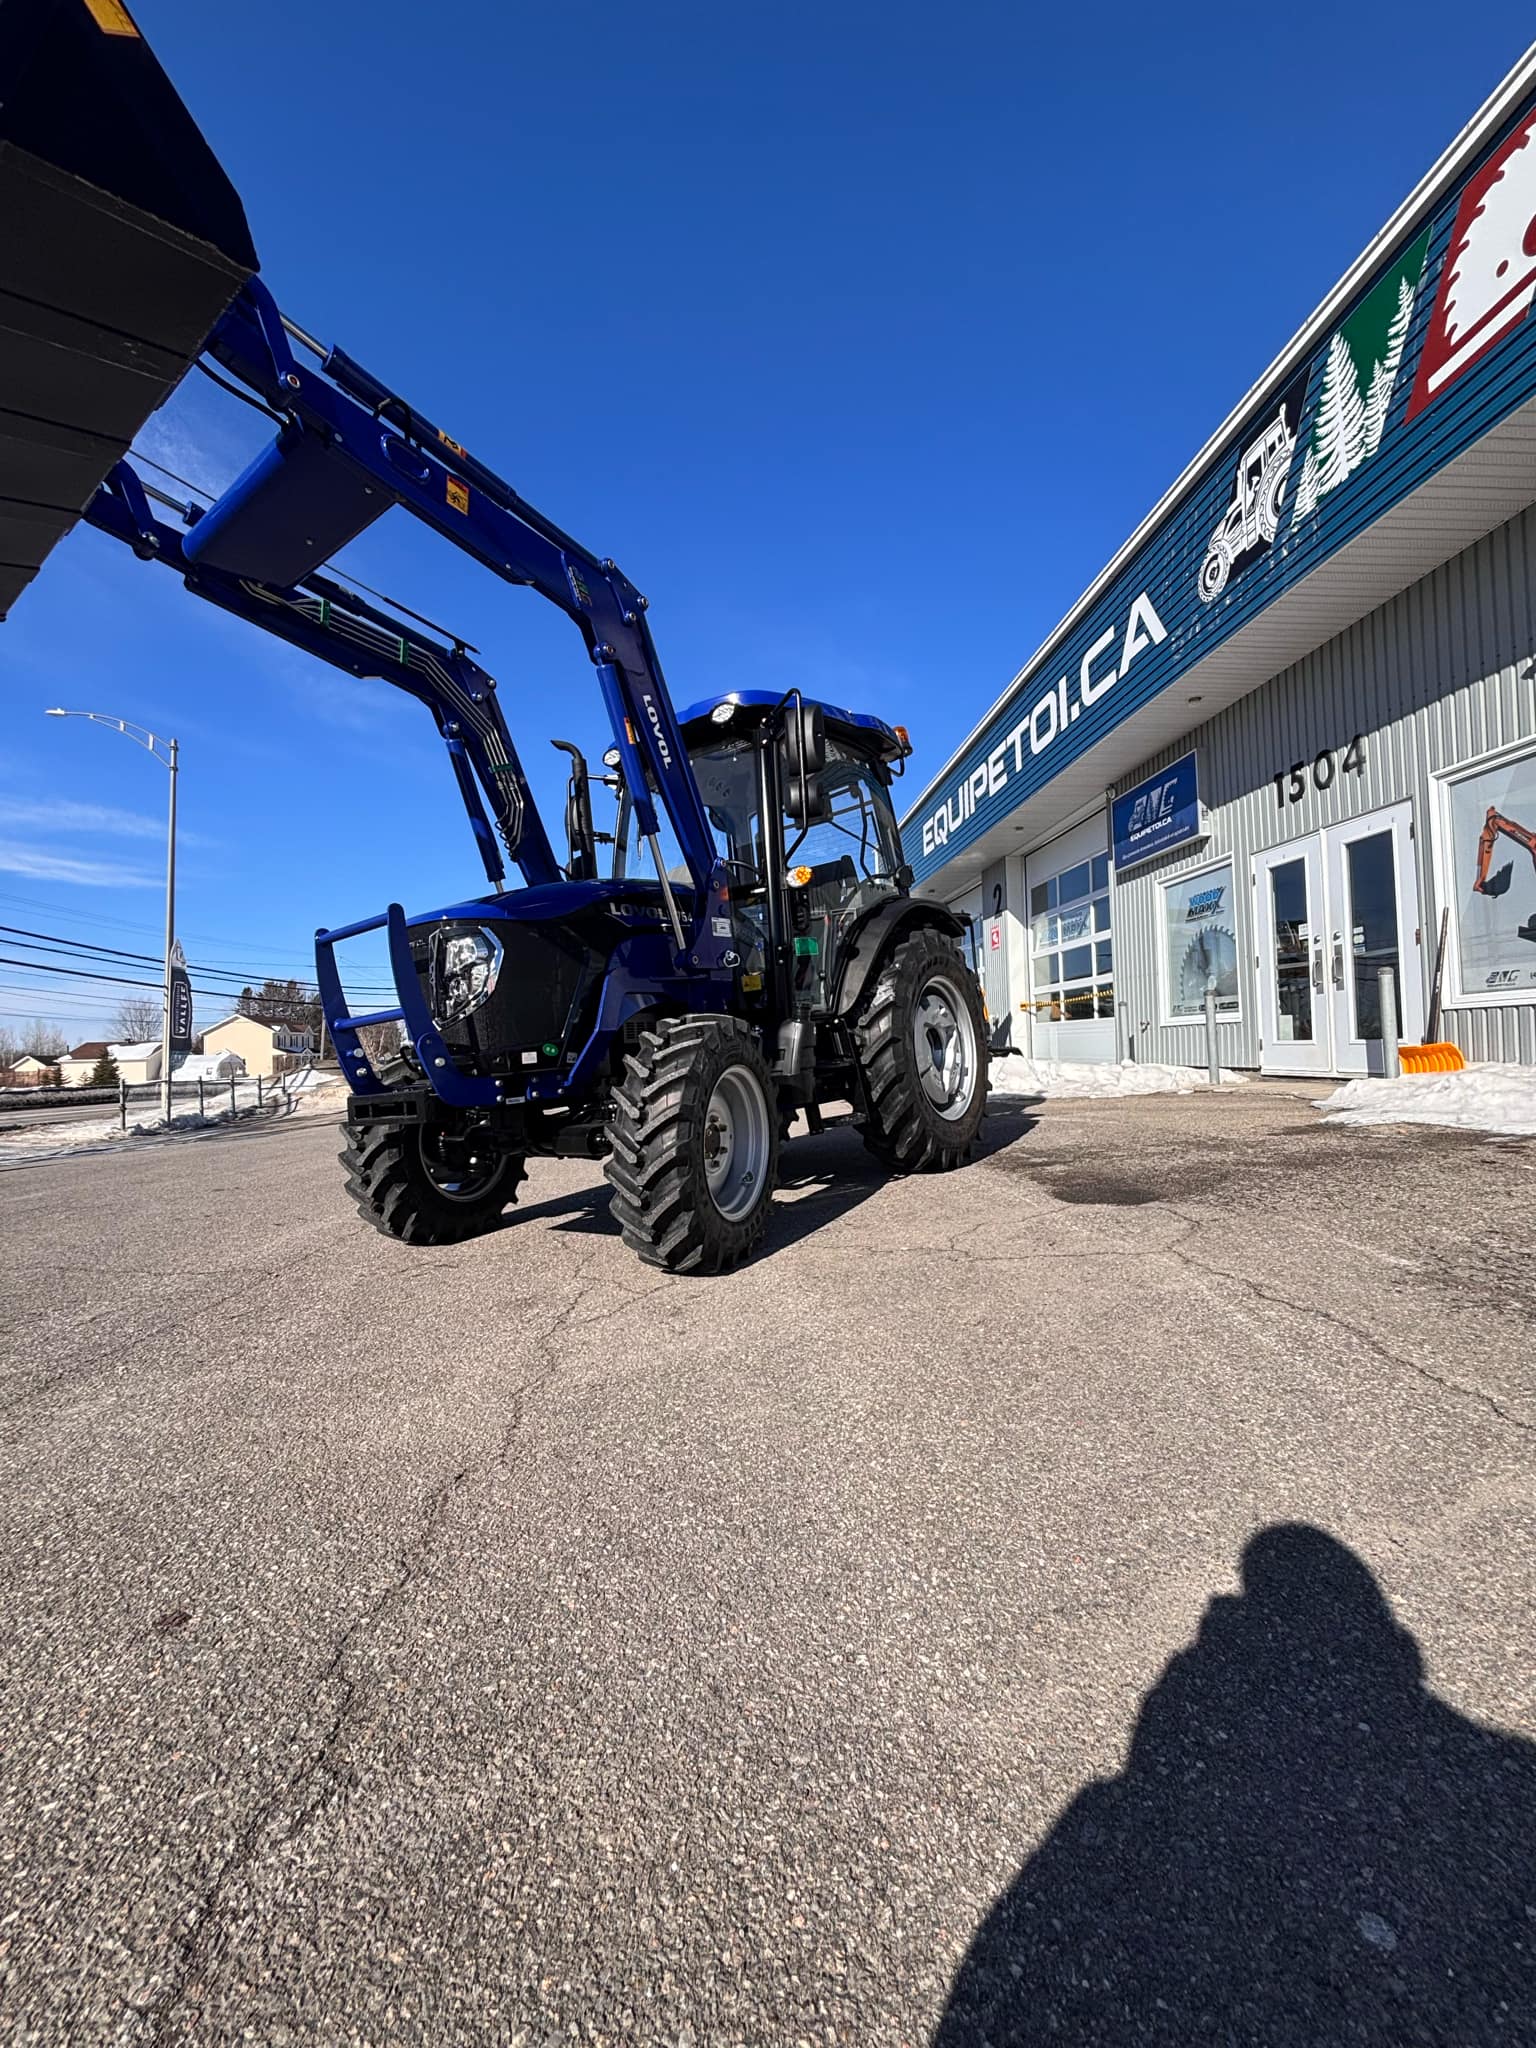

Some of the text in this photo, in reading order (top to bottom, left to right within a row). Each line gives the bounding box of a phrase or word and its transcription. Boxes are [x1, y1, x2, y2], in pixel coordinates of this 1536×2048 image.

[643, 694, 672, 770] LOVOL
[923, 592, 1168, 857] EQUIPETOI.CA
[1273, 733, 1366, 809] 1504
[609, 902, 668, 921] LOVOL
[993, 884, 1003, 919] 2
